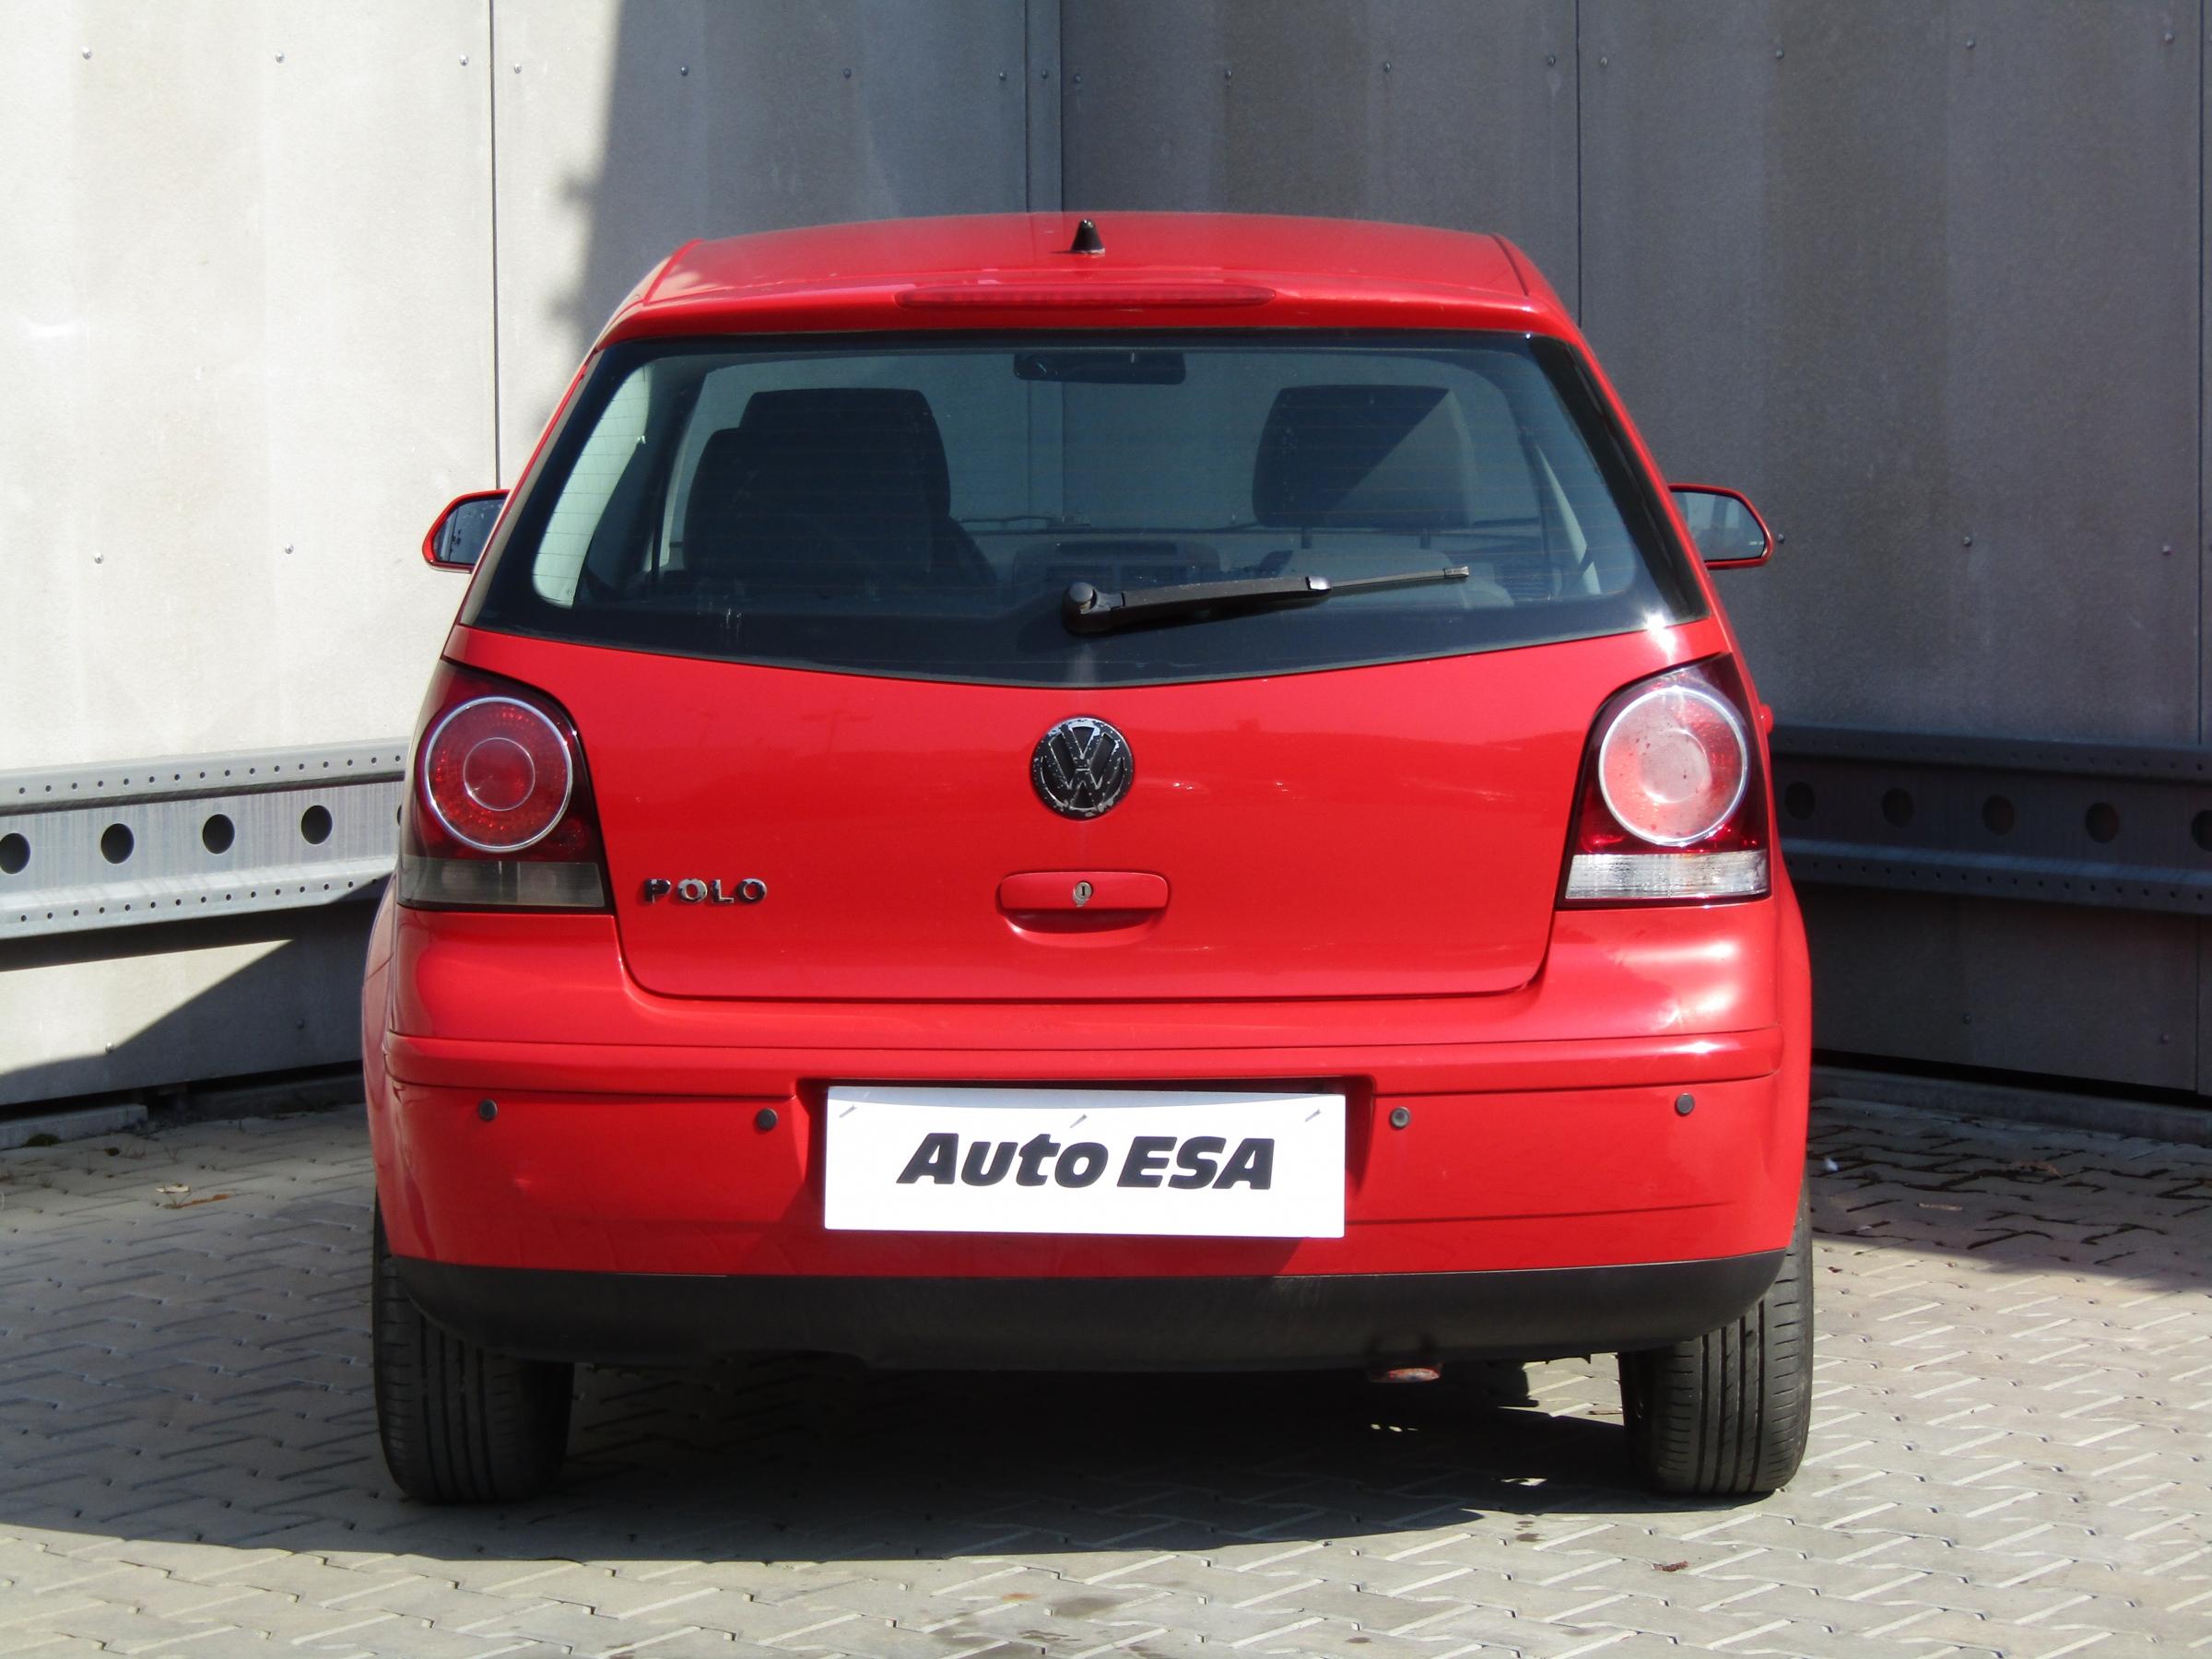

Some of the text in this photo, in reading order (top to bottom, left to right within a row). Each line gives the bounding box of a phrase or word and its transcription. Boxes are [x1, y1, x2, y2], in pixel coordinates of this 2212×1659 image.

[1034, 720, 1130, 816] VW
[644, 877, 768, 904] POLO
[896, 1133, 1275, 1190] Auto ESA
